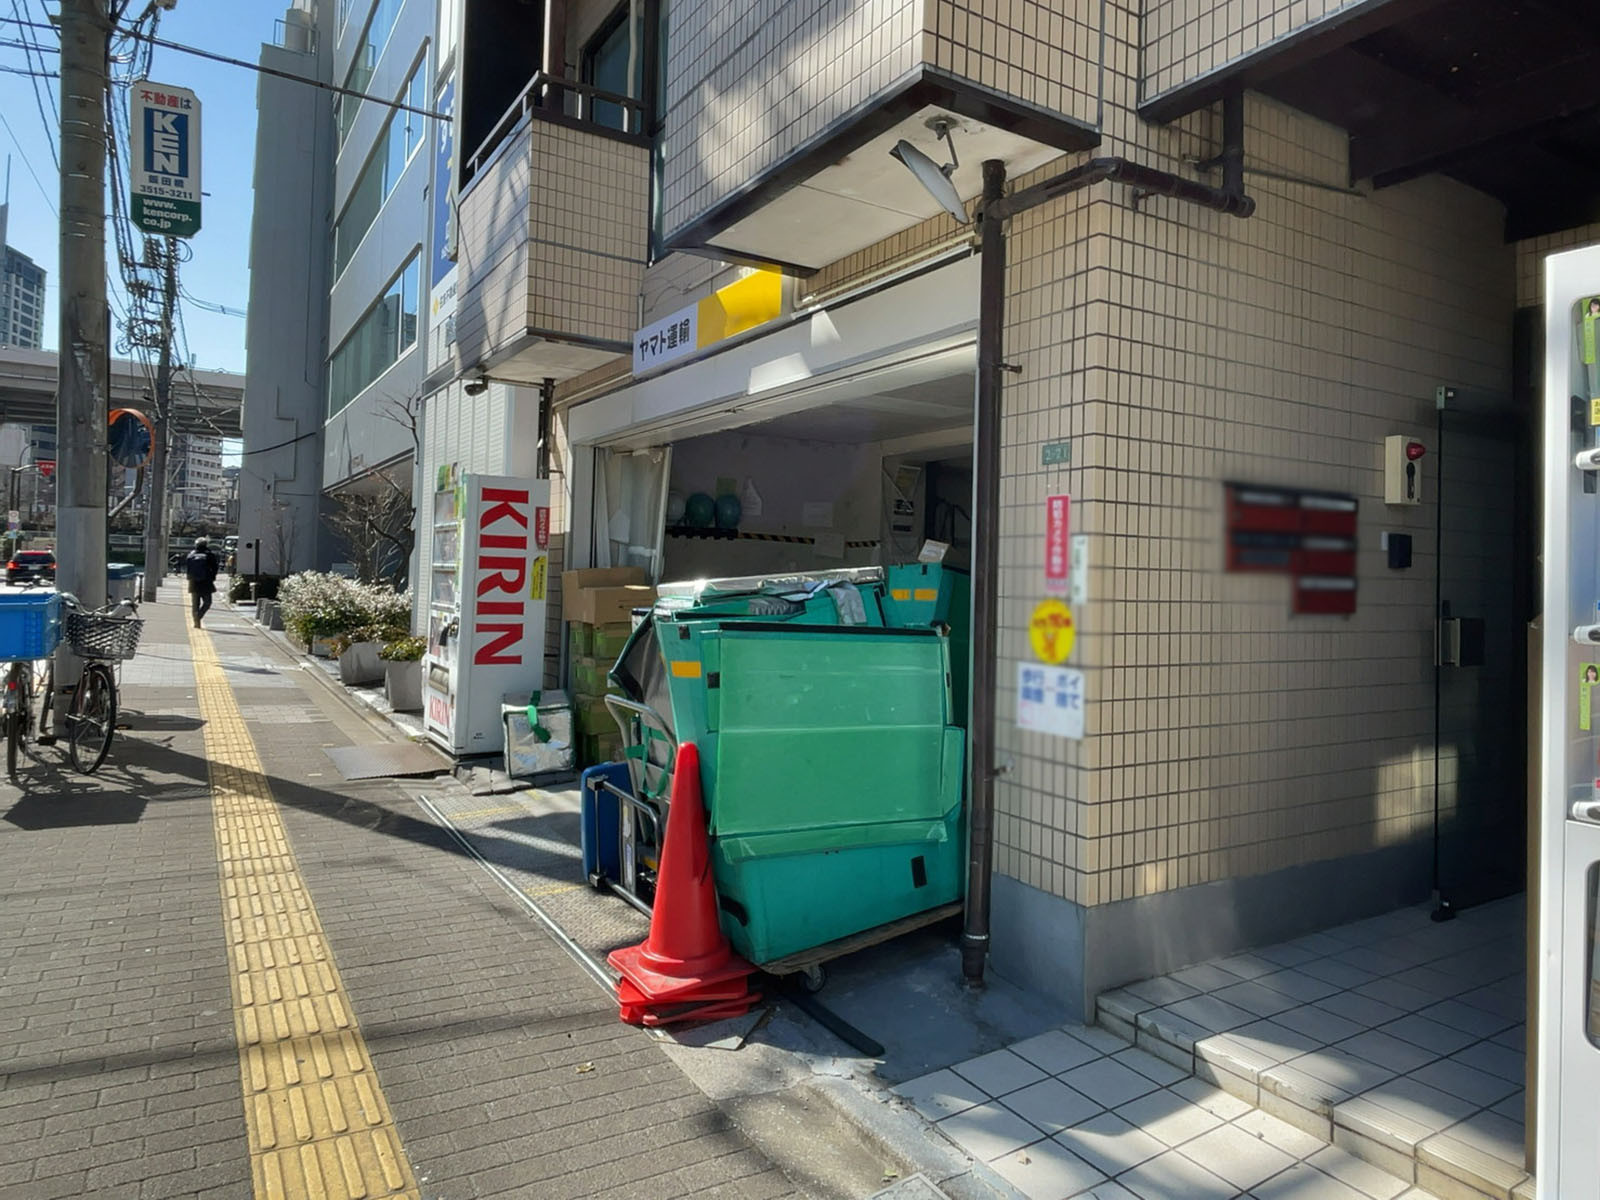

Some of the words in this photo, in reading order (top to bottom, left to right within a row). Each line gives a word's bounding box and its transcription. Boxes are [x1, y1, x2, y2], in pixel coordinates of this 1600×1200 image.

[140, 89, 192, 110] 不動産は
[153, 111, 180, 174] KEN
[140, 185, 193, 200] 3515-3211
[142, 199, 177, 210] www.
[142, 207, 193, 222] kencorp.
[142, 218, 172, 229] co.jp
[639, 318, 690, 361] ヤマト運輸
[473, 487, 529, 665] KIRIN
[429, 695, 451, 731] KIRIN
